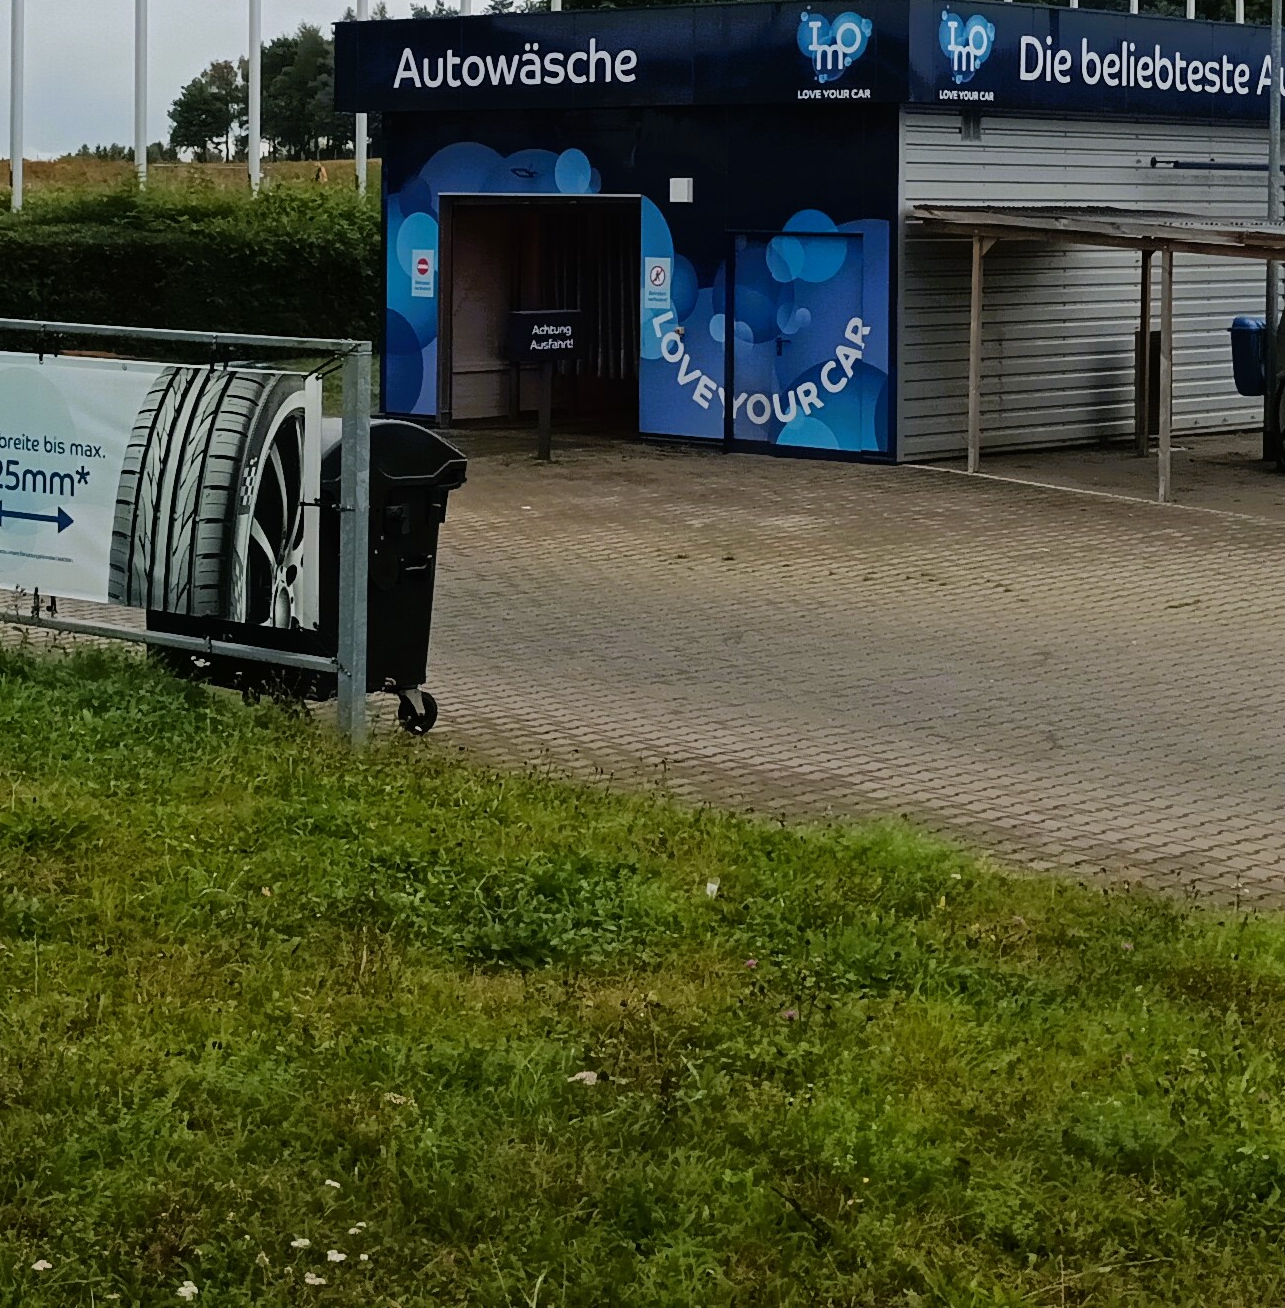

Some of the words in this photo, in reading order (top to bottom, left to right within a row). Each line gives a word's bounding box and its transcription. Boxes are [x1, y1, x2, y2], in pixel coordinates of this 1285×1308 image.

[393, 38, 637, 88] Autowäsche
[1019, 35, 1072, 84] Die
[1081, 37, 1250, 95] beliebteste
[797, 90, 821, 99] LOVE
[822, 89, 849, 99] YOUR
[851, 89, 871, 98] CAR
[939, 90, 958, 100] LOVE
[958, 90, 979, 101] YOUR
[979, 91, 994, 101] CAR
[532, 324, 572, 336] Achtung
[530, 339, 573, 350] Ausfahrt!
[652, 311, 717, 410] LOVE
[718, 382, 824, 425] YOUR
[820, 317, 871, 393] CAR
[44, 435, 65, 454] bis
[70, 443, 106, 459] max.
